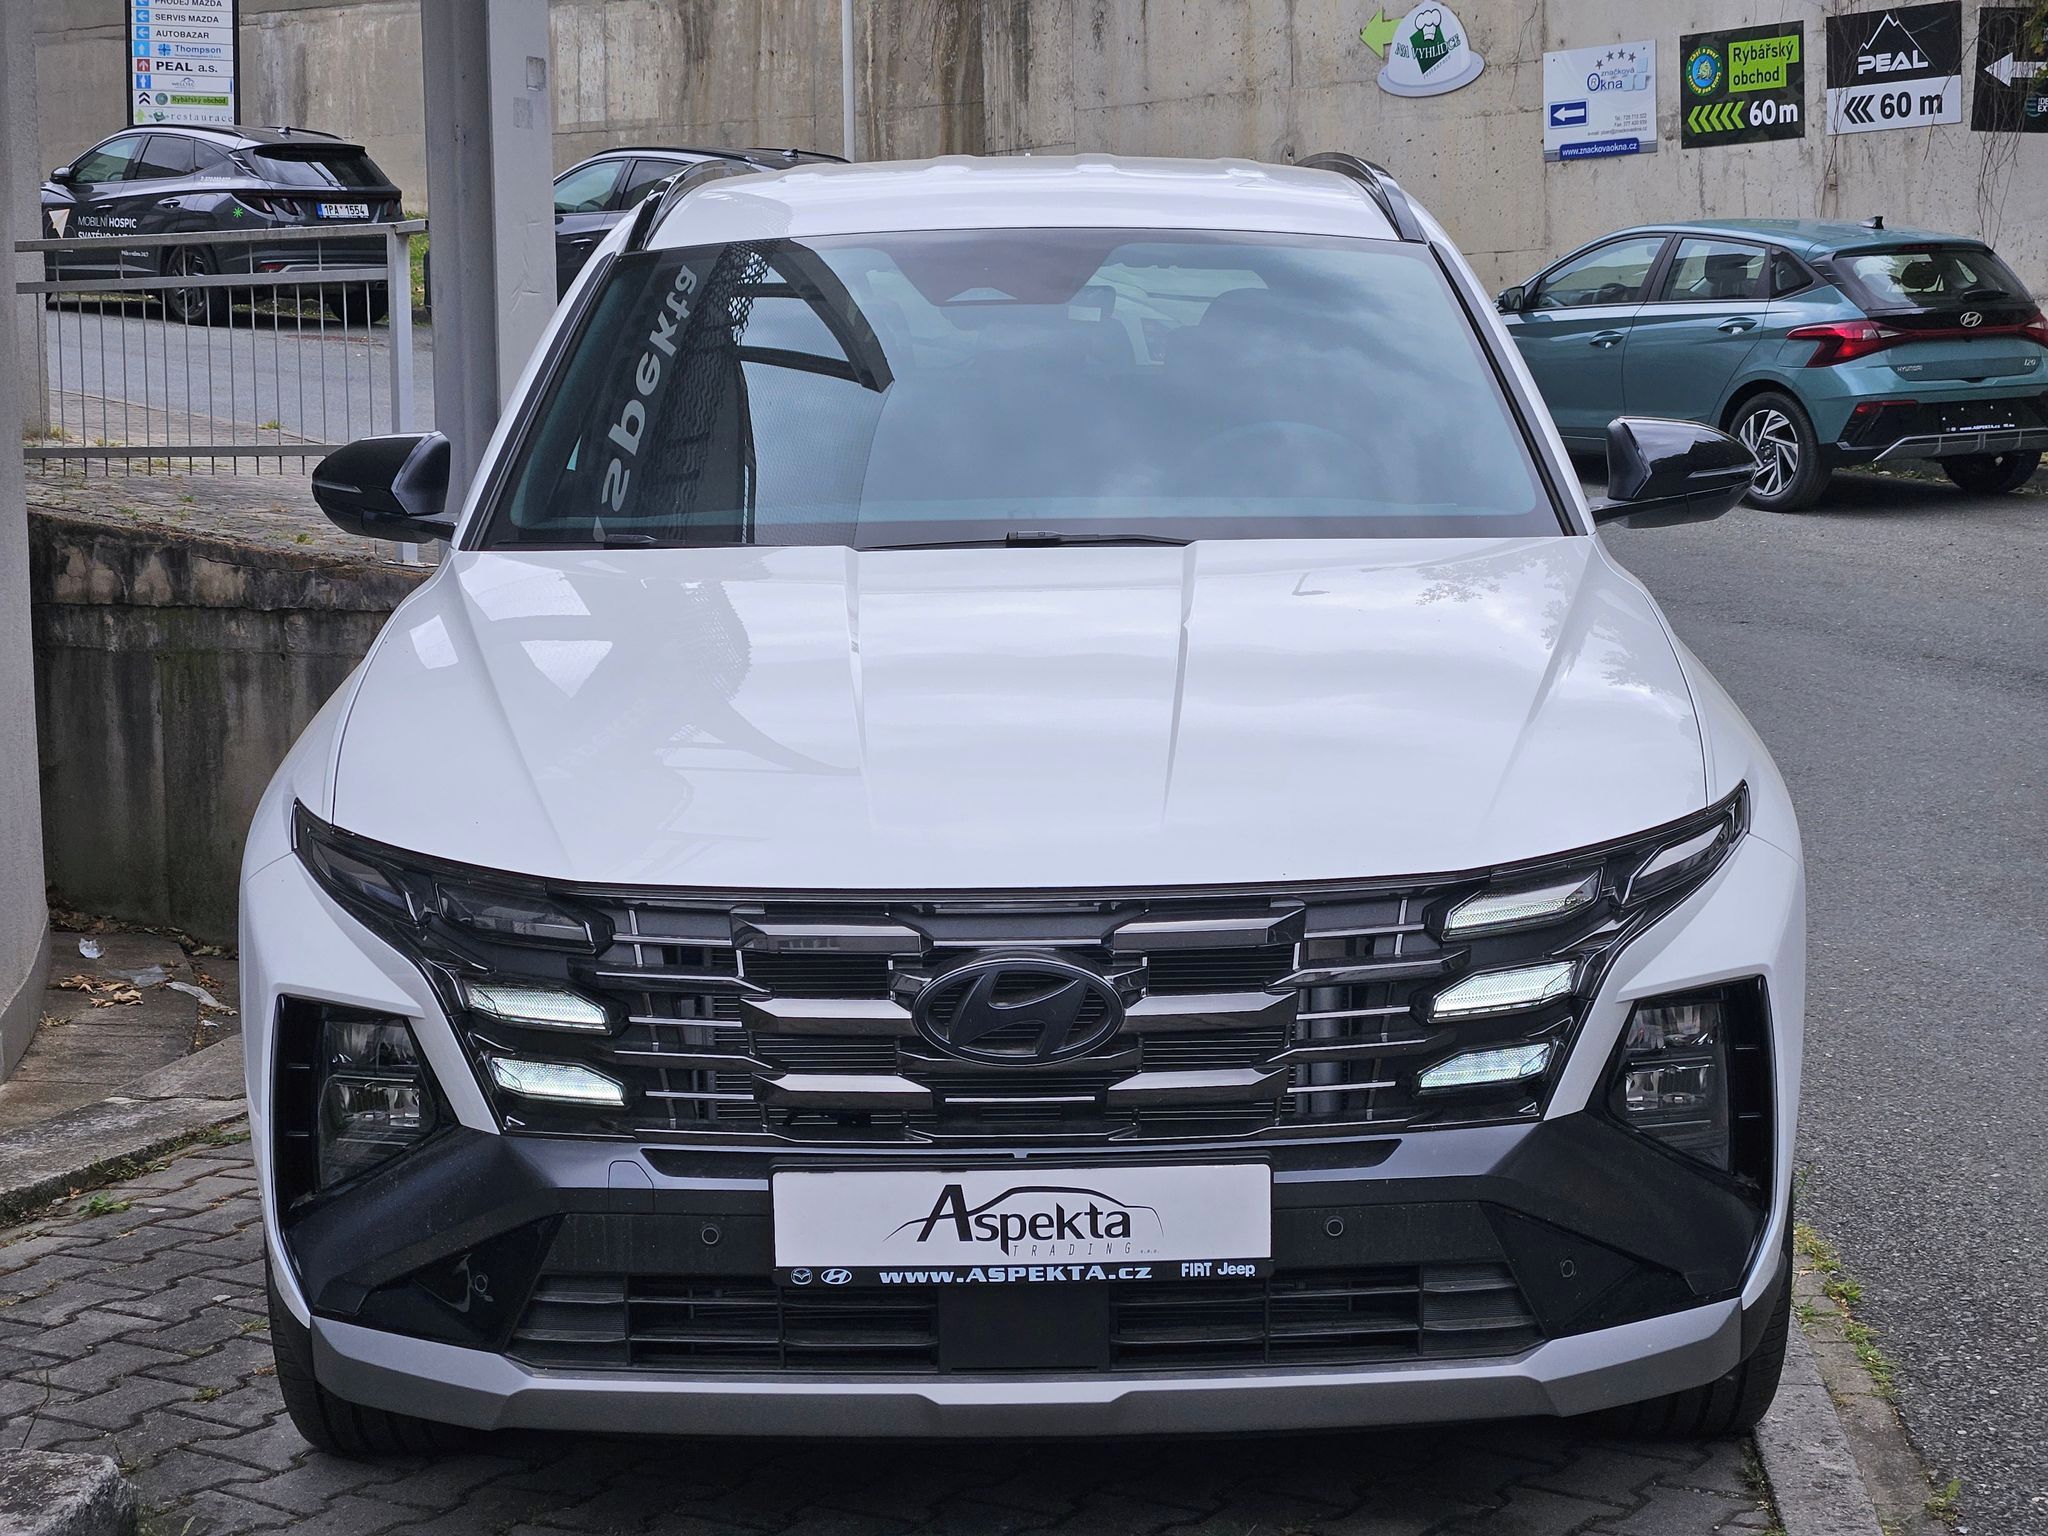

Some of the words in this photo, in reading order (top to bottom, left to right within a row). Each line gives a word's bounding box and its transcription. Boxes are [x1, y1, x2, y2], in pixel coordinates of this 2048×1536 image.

[155, 14, 186, 22] SERVIS
[188, 15, 219, 23] MAZDA
[156, 30, 210, 39] AUTOBAZAR
[175, 44, 221, 55] Thompson
[1733, 41, 1794, 66] Rybářský
[156, 61, 193, 72] PEAL
[198, 64, 218, 73] a.s.
[1857, 50, 1930, 76] PEAL
[1587, 73, 1623, 91] Okna
[1733, 66, 1780, 86] obchod
[1749, 99, 1777, 126] 60
[1779, 103, 1798, 123] m
[1879, 91, 1912, 119] 60
[1919, 93, 1943, 116] m
[170, 112, 233, 123] restaurace
[1561, 142, 1638, 156] www.znackovaokna.cz
[324, 205, 339, 215] 1PA
[345, 205, 364, 215] 1554
[77, 214, 108, 227] MOBILNÍ
[109, 217, 137, 229] HOSPIC
[916, 1184, 1132, 1257] Aspekta
[1012, 1242, 1132, 1257] TRADING
[879, 1265, 1153, 1284] www.ASPEKTA.cz
[1181, 1262, 1212, 1278] FIAT
[1217, 1262, 1255, 1278] Jeep
